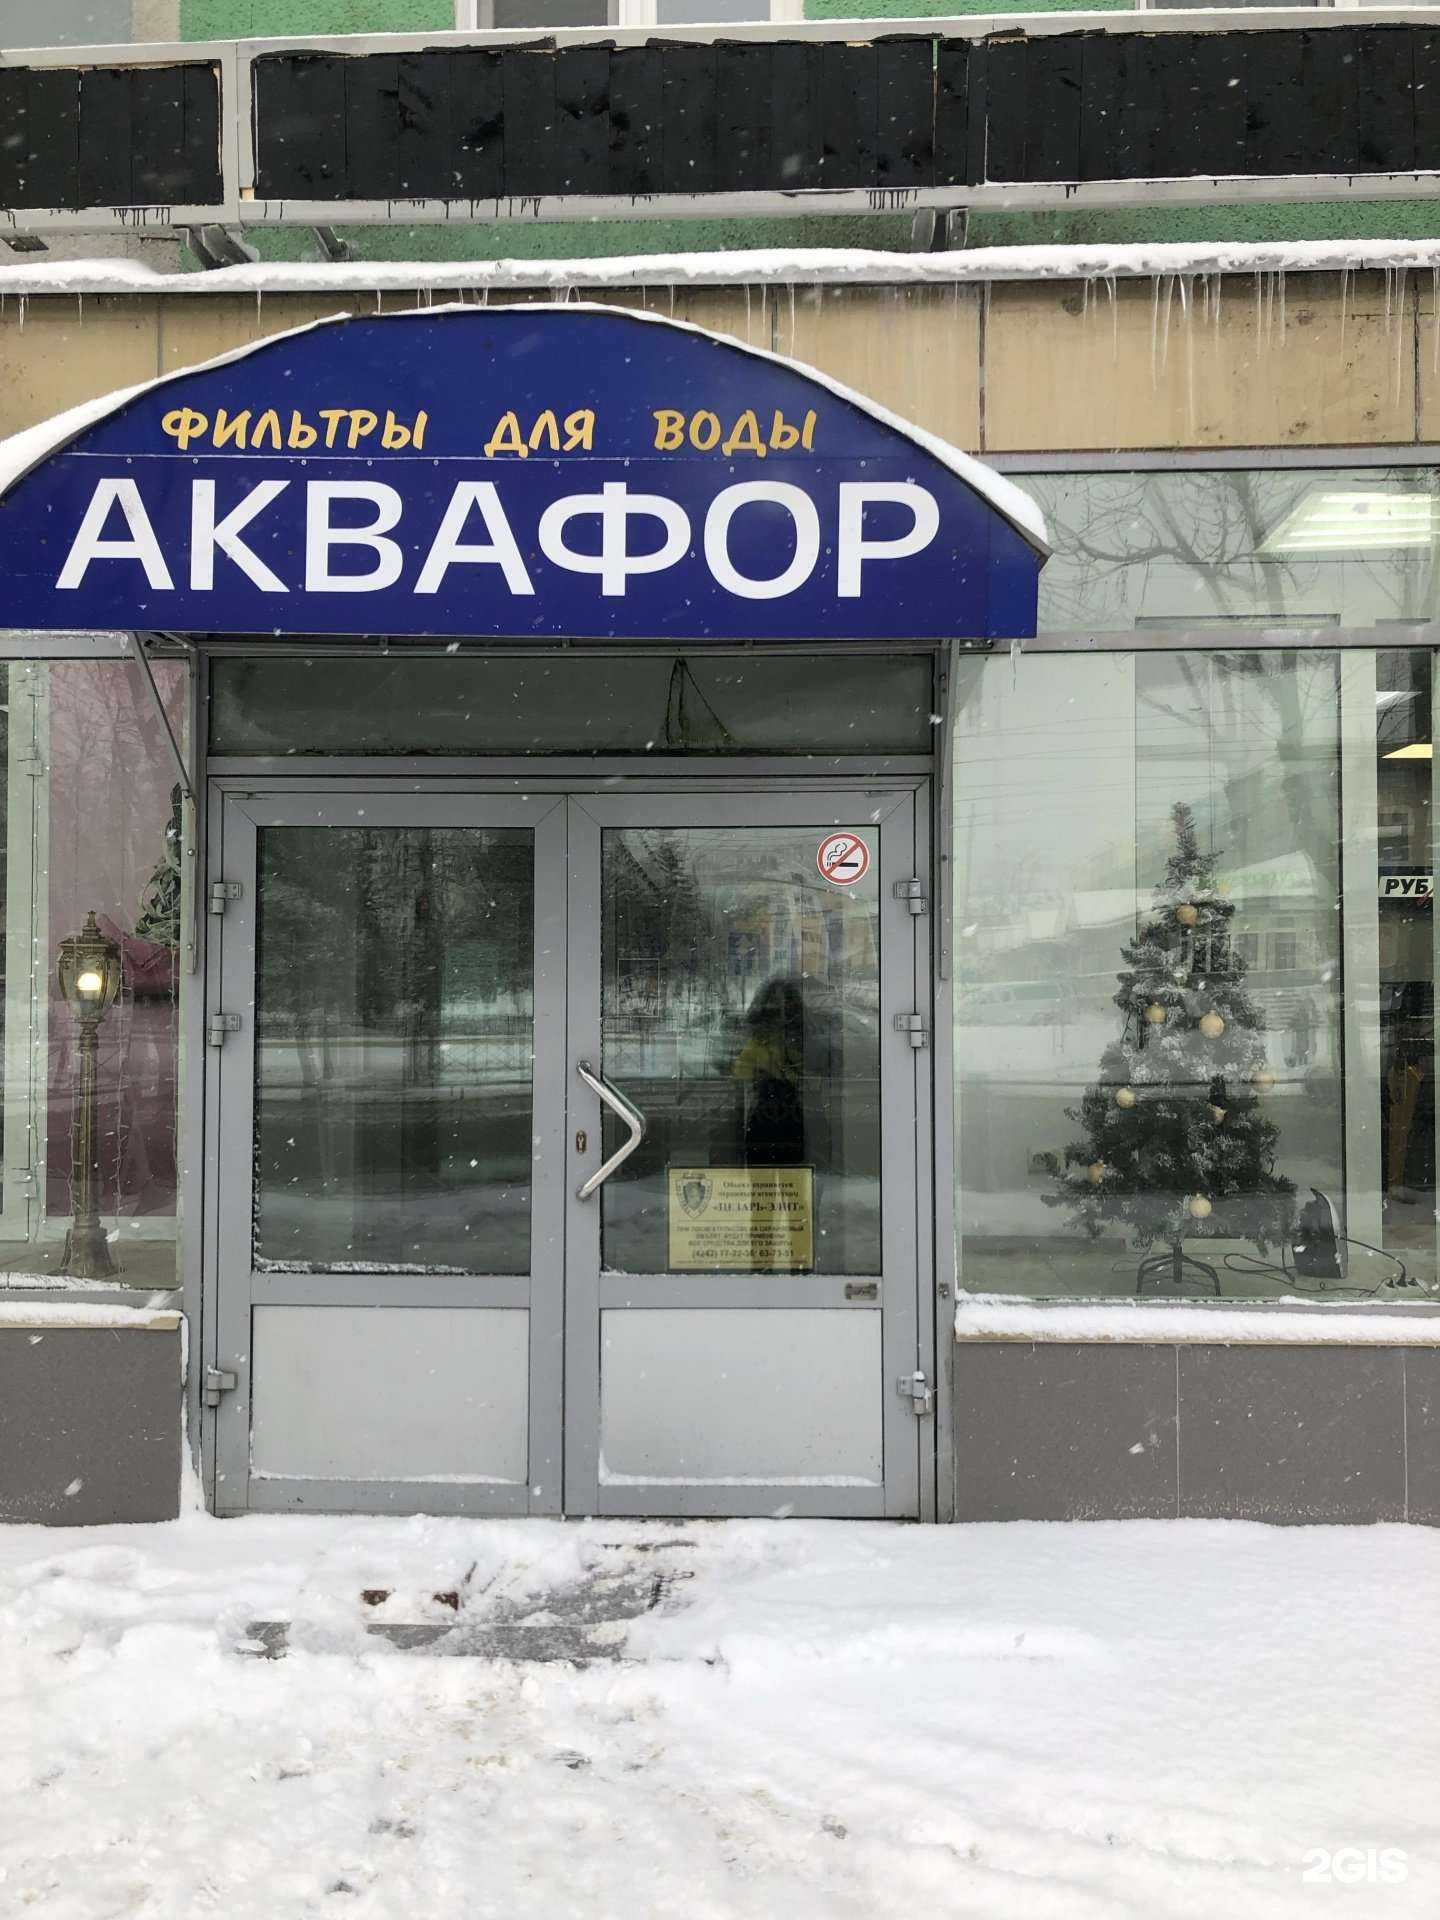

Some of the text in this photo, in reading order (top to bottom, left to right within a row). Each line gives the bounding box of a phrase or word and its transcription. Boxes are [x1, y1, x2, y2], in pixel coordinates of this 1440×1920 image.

[162, 407, 817, 458] ФИЛЬТРЫ ДЛЯ ВОДЫ
[55, 477, 941, 600] АКВАФОР
